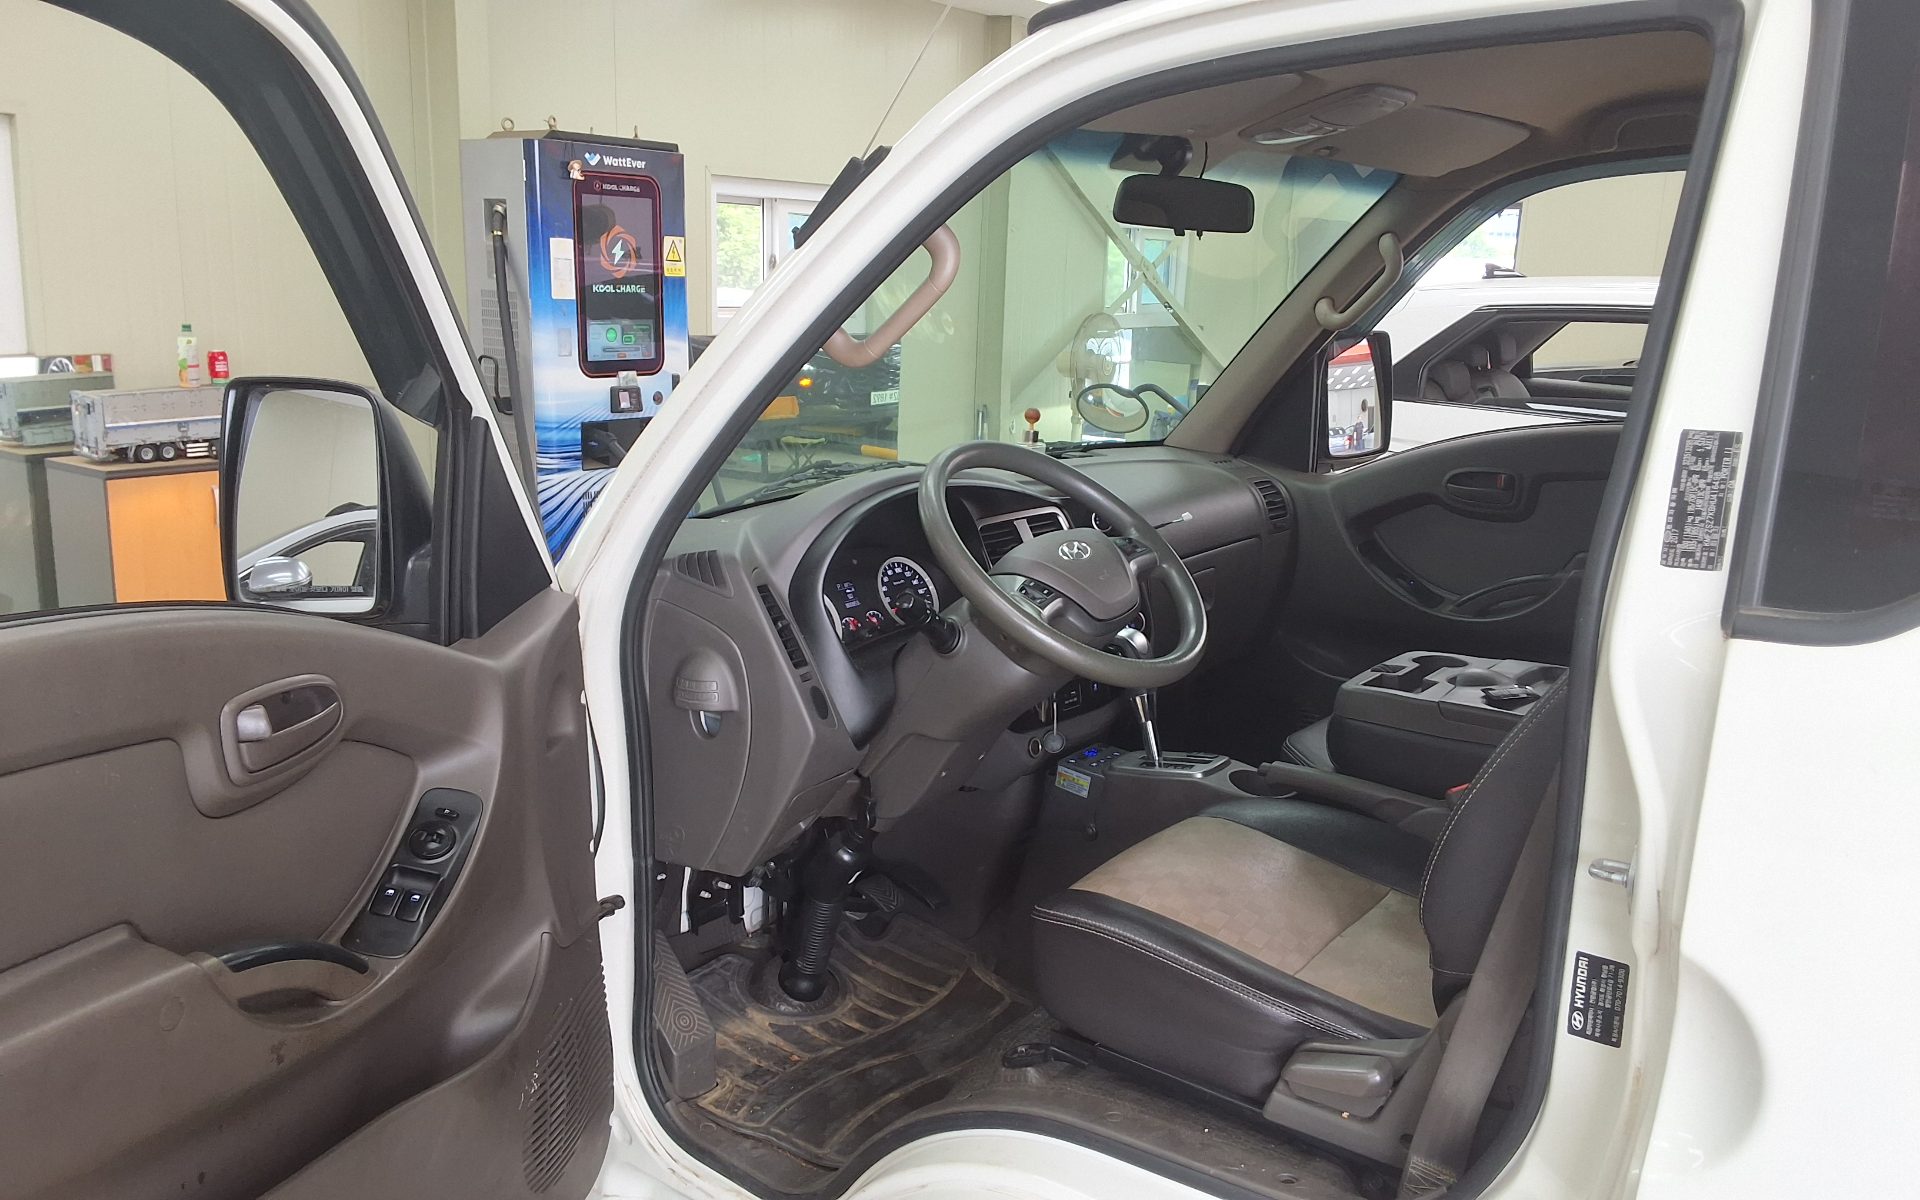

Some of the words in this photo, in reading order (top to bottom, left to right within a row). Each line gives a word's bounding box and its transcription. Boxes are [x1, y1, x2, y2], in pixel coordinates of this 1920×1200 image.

[602, 156, 646, 168] WattEver
[592, 284, 616, 292] KOOL
[616, 284, 646, 292] CHARGE
[1721, 457, 1731, 478] PORTER
[1670, 529, 1679, 543] 2017
[1574, 956, 1588, 1008] HYUNDAI
